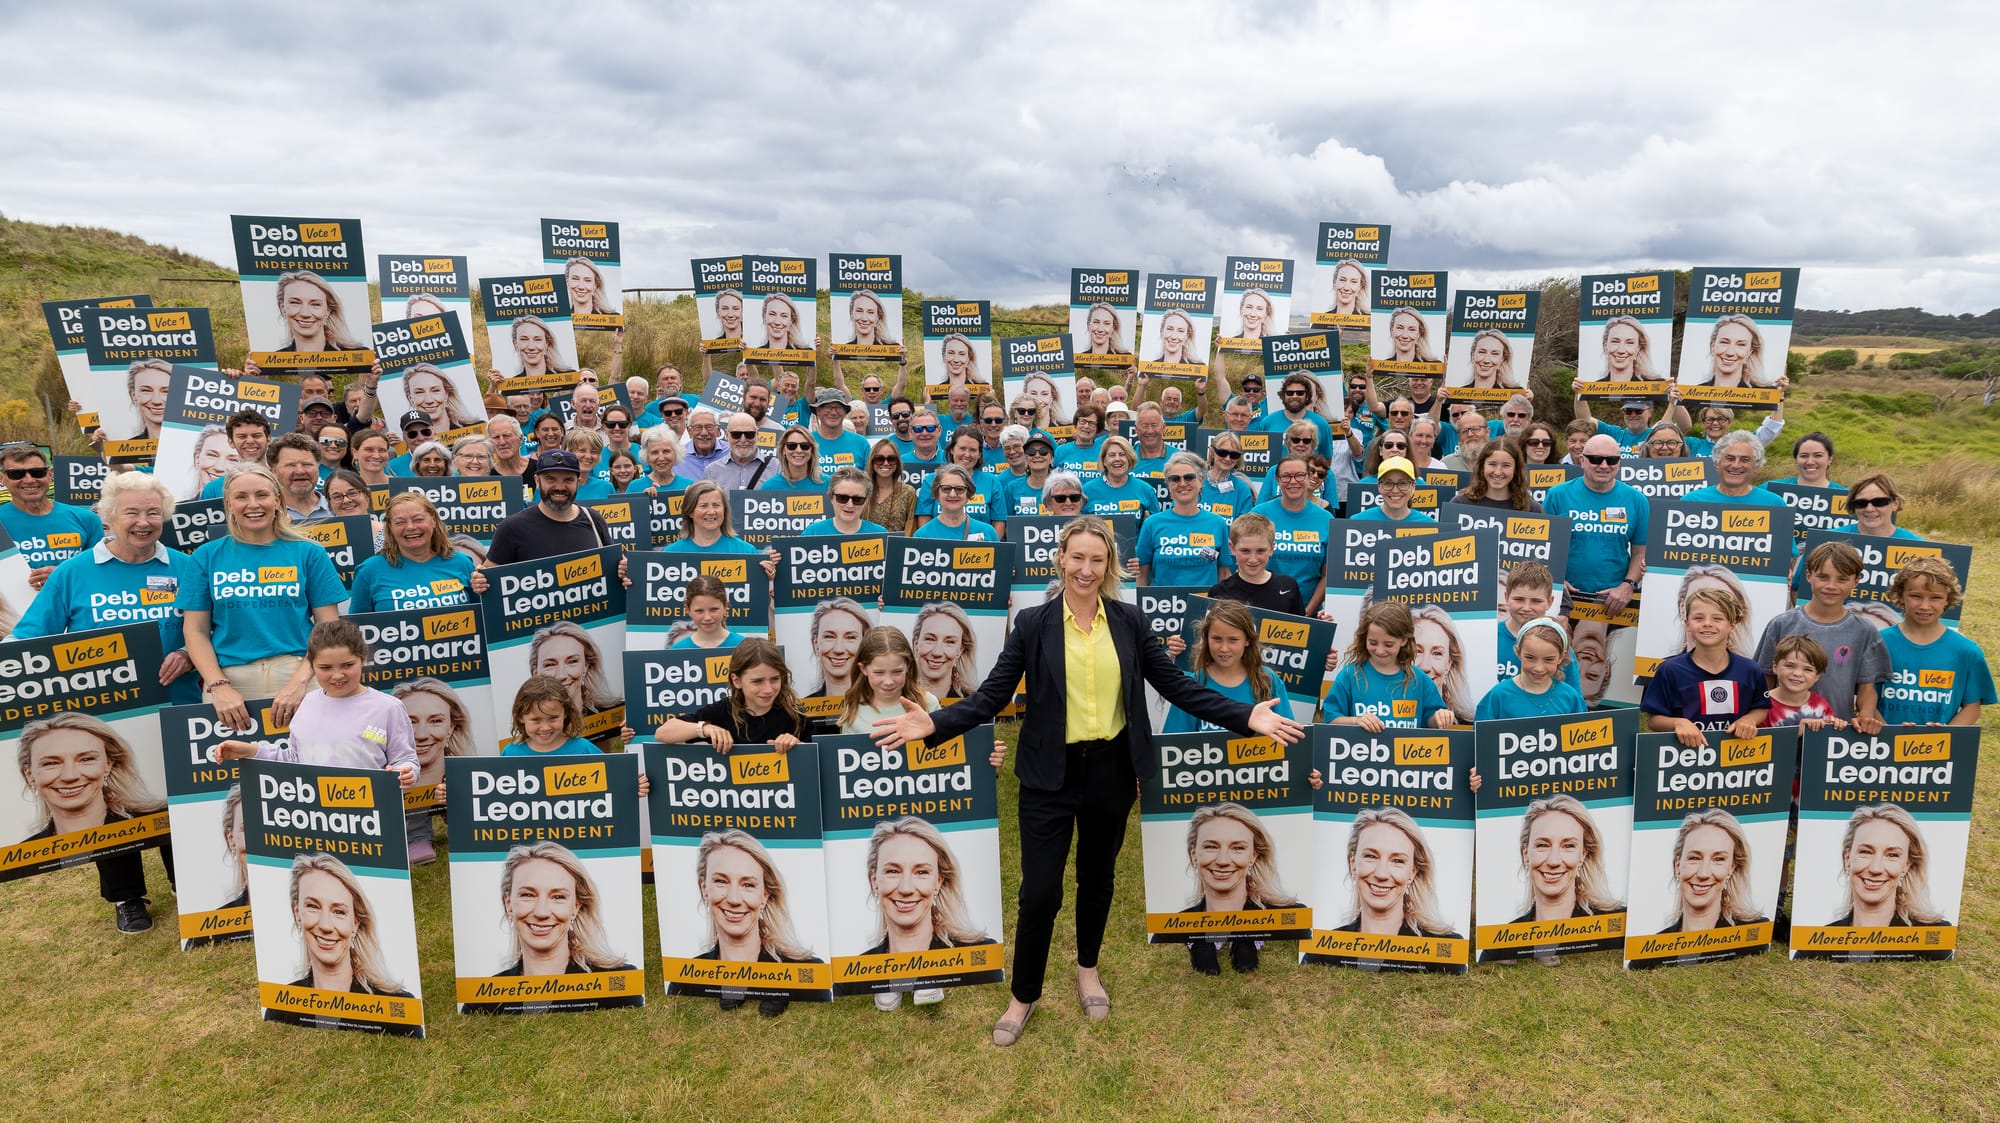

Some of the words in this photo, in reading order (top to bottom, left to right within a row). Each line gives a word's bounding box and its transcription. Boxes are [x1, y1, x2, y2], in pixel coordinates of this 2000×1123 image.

[250, 224, 298, 241] Deb
[306, 228, 329, 239] Vote
[330, 227, 337, 237] 1
[551, 224, 580, 237] Deb
[584, 227, 599, 236] Vote
[1328, 228, 1354, 239] Deb
[252, 241, 347, 258] Leonard
[552, 235, 609, 249] Leonard
[1327, 238, 1380, 251] Leonard
[553, 249, 609, 257] INDEPENDENT
[1326, 251, 1378, 259] INDEPENDENT
[255, 260, 348, 270] INDEPENDENT
[752, 261, 779, 273] Deb
[838, 259, 865, 270] Deb
[752, 272, 807, 285] Leonard
[839, 270, 892, 281] Leonard
[1080, 273, 1105, 284] Deb
[1381, 276, 1408, 287] Deb
[1412, 278, 1427, 286] Vote
[1704, 274, 1743, 288] Deb
[1750, 276, 1770, 286] Vote
[491, 282, 524, 295] Deb
[752, 285, 807, 293] INDEPENDENT
[1079, 283, 1129, 295] Leonard
[1156, 279, 1181, 290] Deb
[1380, 286, 1437, 298] Leonard
[1592, 279, 1626, 294] Deb
[1632, 280, 1649, 290] Vote
[493, 292, 558, 307] Leonard
[1154, 289, 1206, 302] Leonard
[1380, 299, 1436, 307] INDEPENDENT
[1465, 295, 1496, 308] Deb
[1501, 297, 1517, 306] Vote
[1592, 290, 1661, 306] Leonard
[1702, 288, 1782, 303] Leonard
[496, 306, 559, 316] INDEPENDENT
[1464, 308, 1527, 320] Leonard
[1592, 306, 1660, 316] INDEPENDENT
[1701, 305, 1780, 314] INDEPENDENT
[98, 315, 147, 331] Deb
[154, 317, 177, 329] Vote
[101, 330, 197, 347] Leonard
[1272, 339, 1300, 352] Deb
[105, 349, 198, 359] INDEPENDENT
[265, 354, 348, 364] MoreForMonash
[1273, 347, 1330, 363] Leonard
[1667, 509, 1718, 530] Deb
[1729, 515, 1755, 528] Vote
[1757, 516, 1765, 527] 1
[1665, 528, 1773, 553] Leonard
[790, 544, 839, 565] Deb
[848, 546, 871, 560] Vote
[873, 544, 879, 555] 1
[903, 547, 950, 567] Deb
[959, 552, 982, 565] Vote
[984, 552, 990, 563] 1
[1388, 545, 1431, 569] Deb
[1439, 545, 1462, 561] Vote
[1464, 542, 1471, 555] 1
[1663, 551, 1771, 567] INDEPENDENT
[213, 568, 256, 586] Deb
[264, 570, 285, 580] Vote
[500, 569, 554, 596] Deb
[564, 566, 588, 581] Vote
[590, 560, 596, 572] 1
[791, 560, 886, 584] Leonard
[901, 566, 996, 588] Leonard
[1388, 562, 1479, 590] Leonard
[90, 590, 138, 607] Deb
[213, 582, 300, 600] Leonard
[500, 573, 607, 616] Leonard
[792, 584, 881, 598] INDEPENDEN
[900, 589, 993, 601] INDEPENDENT
[502, 596, 608, 630] INDEPENDENT
[0, 652, 51, 678] eb
[66, 646, 104, 665] Vote
[108, 640, 117, 654] 1
[0, 660, 138, 704] eonard
[0, 688, 141, 722] DEPENDENT
[1355, 702, 1390, 716] Deb
[1499, 728, 1557, 755] Deb
[1569, 728, 1597, 746] Vote
[1600, 725, 1608, 738] 1
[1827, 736, 1890, 760] Deb
[1903, 740, 1933, 757] Vote
[1936, 740, 1945, 753] 1
[838, 746, 903, 772] Deb
[916, 745, 948, 764] Vote
[950, 742, 959, 757] 1
[1161, 743, 1224, 767] Deb
[1236, 743, 1266, 760] Vote
[1270, 741, 1278, 753] 1
[1329, 737, 1390, 763] Deb
[1403, 743, 1432, 760] Vote
[1435, 744, 1444, 757] 1
[1658, 743, 1717, 768] Deb
[1728, 744, 1756, 762] Vote
[1759, 742, 1767, 755] 1
[666, 757, 727, 783] Deb
[739, 761, 770, 779] Vote
[773, 759, 781, 774] 1
[1499, 746, 1618, 780] Leonard
[1162, 760, 1289, 788] Leonard
[1329, 762, 1453, 790] Leonard
[1657, 763, 1774, 793] Leonard
[1825, 761, 1953, 785] Leonard
[259, 774, 316, 804] Deb
[326, 783, 356, 802] Vote
[358, 785, 366, 799] 1
[471, 769, 540, 795] Deb
[554, 771, 587, 790] Vote
[590, 769, 600, 784] 1
[839, 765, 972, 799] Leonard
[1499, 776, 1618, 798] INDEPENDENT
[668, 783, 795, 809] Leonard
[1163, 787, 1290, 804] INDEPENDENT
[1328, 791, 1453, 809] INDEPENDENT
[1656, 792, 1772, 810] INDEPENDENT
[1824, 790, 1951, 802] INDEPENDENT
[472, 793, 613, 821] Leonard
[841, 797, 973, 819] INDEPENDENT
[261, 801, 381, 836] Leonard
[671, 813, 797, 828] INDEPENDENT
[474, 825, 614, 841] INDEPENDENT
[3, 821, 146, 865] MoreForMonash
[264, 833, 383, 856] INDEPENDENT
[1163, 913, 1275, 929] MoreForMonash
[1493, 920, 1601, 943] MoreForMonash
[1807, 930, 1919, 945] MoreForMonash
[1316, 935, 1430, 955] MoreForMonash
[1640, 930, 1742, 954] MoreForMonash
[679, 963, 792, 981] MoreForMonash
[843, 953, 964, 977] MoreForMonash
[475, 977, 602, 997] MoreForMonash
[275, 990, 384, 1014] MoreForMonash
